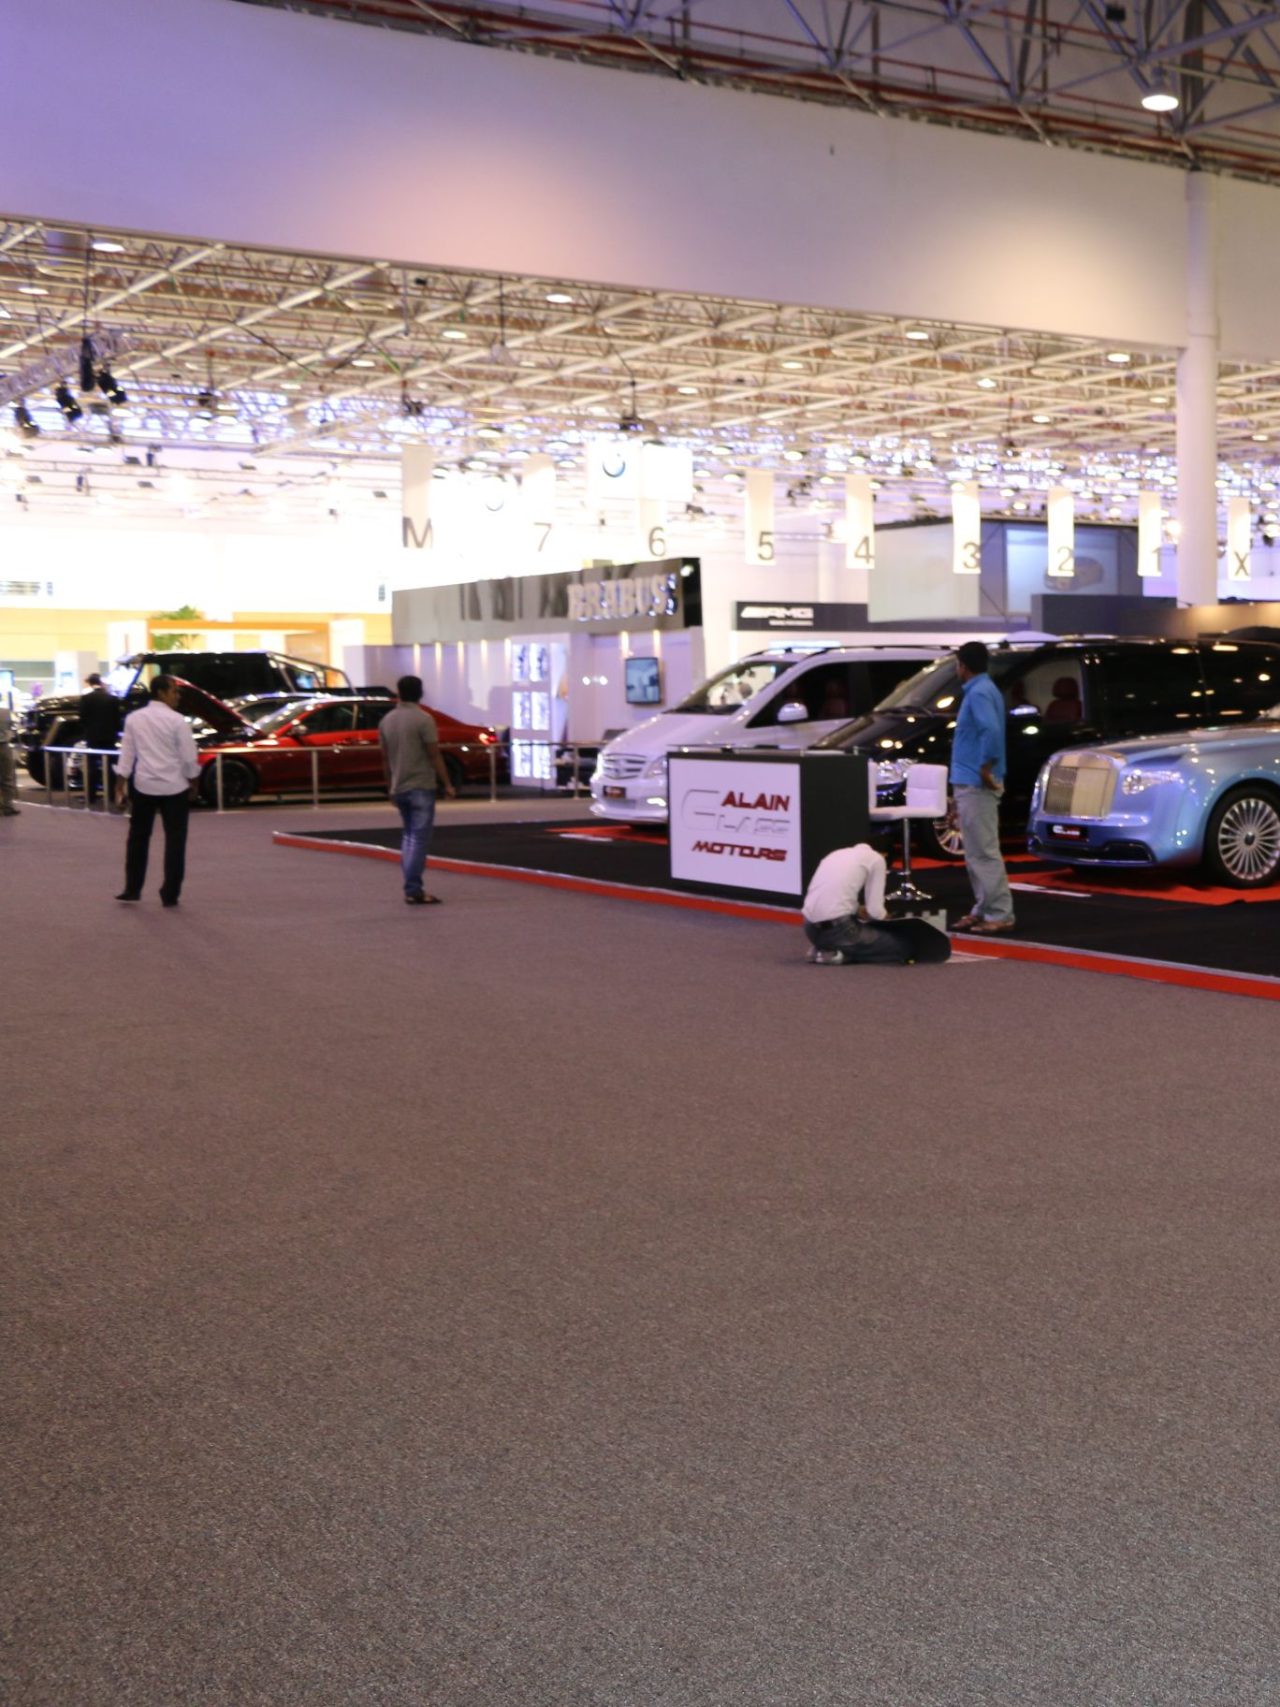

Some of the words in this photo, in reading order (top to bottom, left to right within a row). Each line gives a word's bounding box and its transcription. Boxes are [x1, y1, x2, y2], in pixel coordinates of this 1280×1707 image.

[402, 516, 433, 548] M
[533, 522, 552, 552] 7
[649, 526, 667, 557] 6
[757, 531, 775, 561] 5
[853, 536, 875, 565] 4
[962, 542, 982, 570] 3
[1056, 546, 1074, 572] 2
[1233, 551, 1249, 576] X
